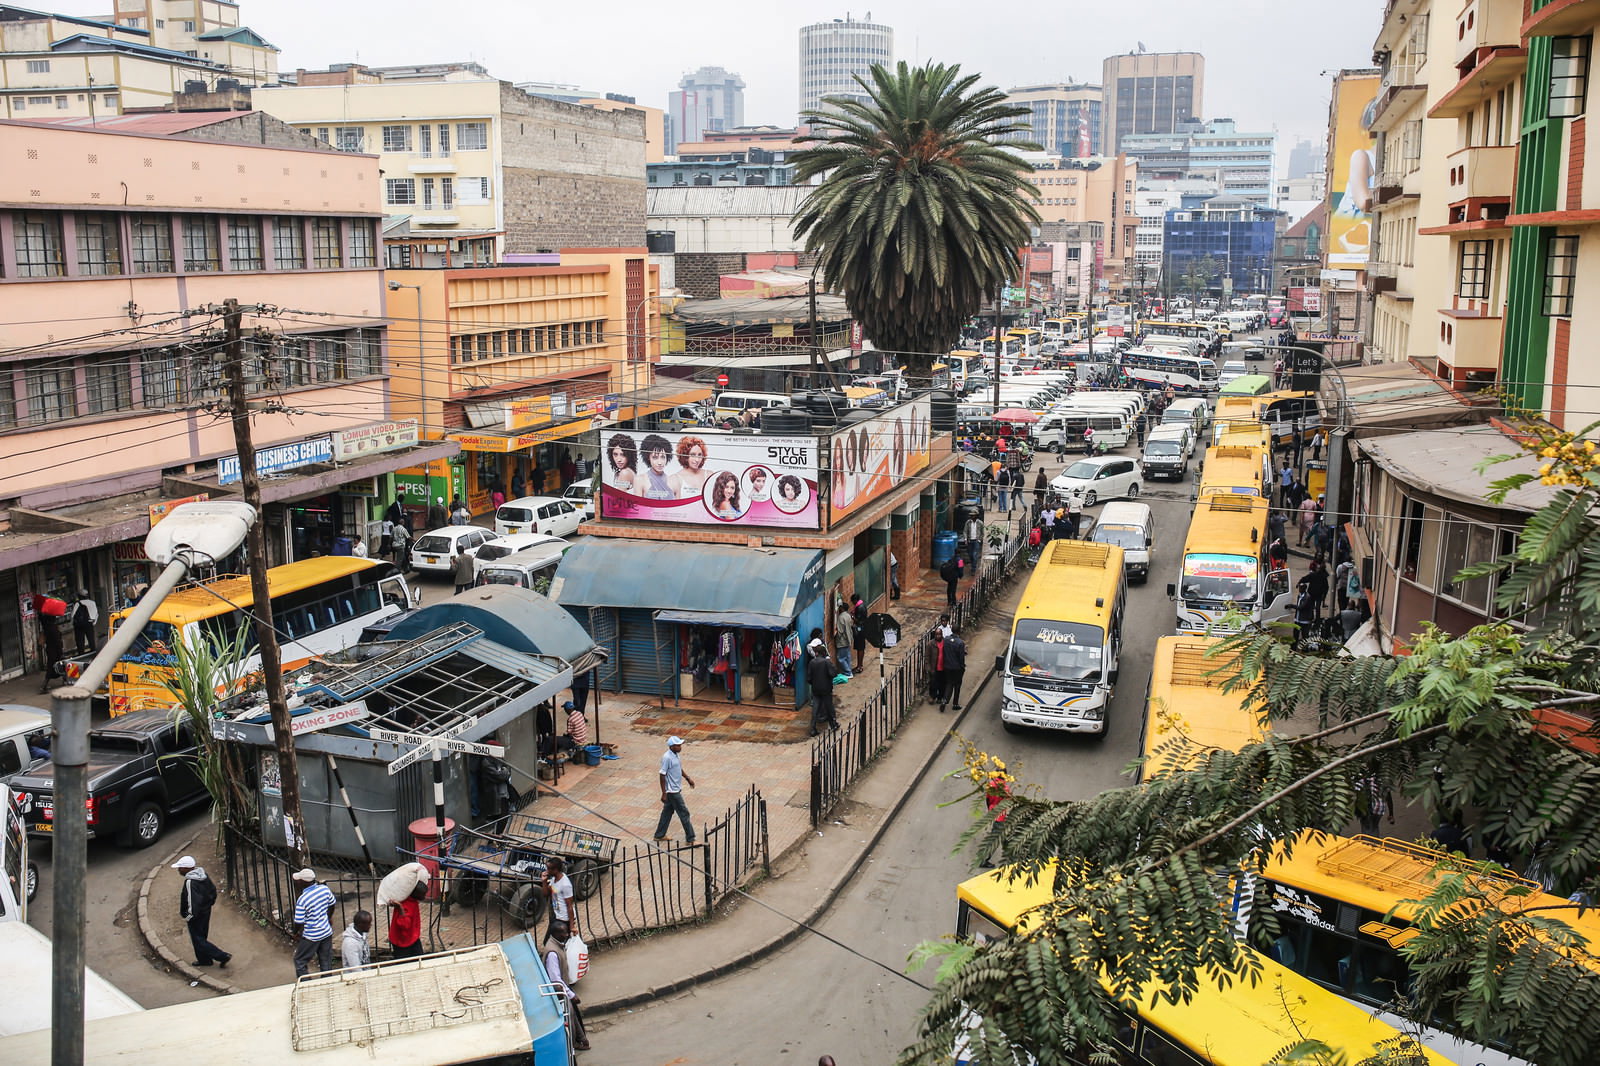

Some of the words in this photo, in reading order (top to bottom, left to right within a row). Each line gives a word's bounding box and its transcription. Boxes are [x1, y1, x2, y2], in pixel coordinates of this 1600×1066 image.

[1297, 357, 1318, 366] Let's
[371, 423, 395, 435] VIDEO
[395, 420, 415, 430] SHOP
[459, 436, 480, 445] Kodak
[480, 438, 503, 447] Express
[219, 457, 241, 480] LATE
[256, 446, 299, 469] BUSINESS
[300, 438, 332, 459] CENTRE
[767, 446, 807, 458] STYLE
[779, 456, 807, 465] ICON
[291, 716, 325, 731] OKING
[327, 707, 361, 722] ZONE
[380, 731, 399, 742] RIVER
[404, 735, 422, 745] ROAD
[418, 743, 431, 758] ROAD
[447, 741, 466, 752] RIVER
[473, 744, 490, 755] ROAD
[1305, 917, 1335, 932] adidas
